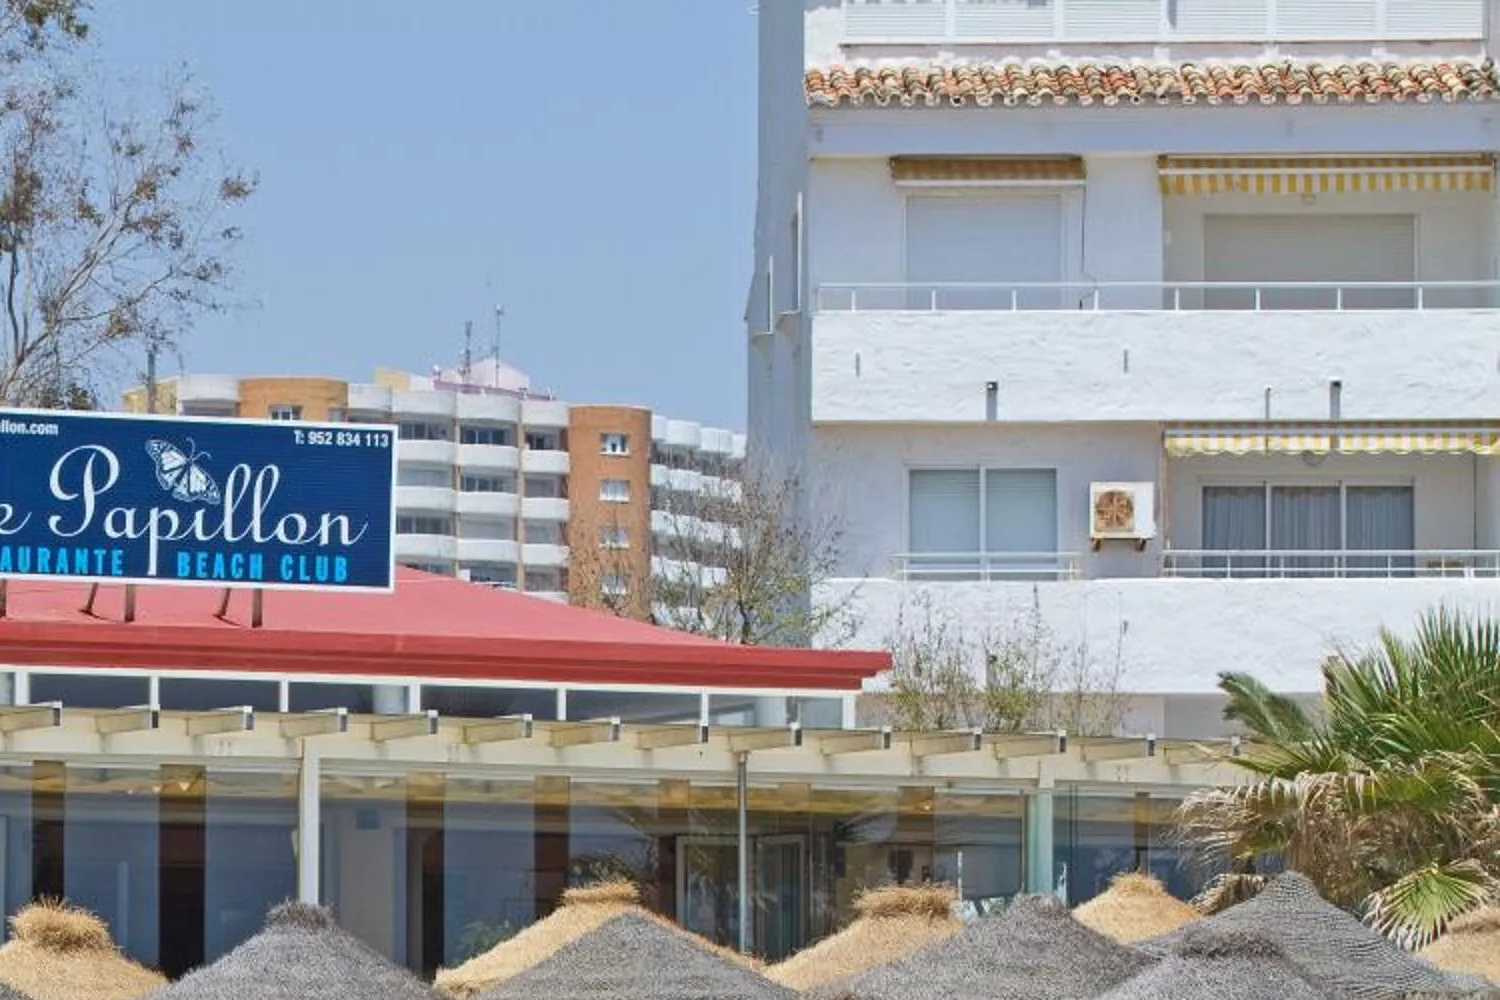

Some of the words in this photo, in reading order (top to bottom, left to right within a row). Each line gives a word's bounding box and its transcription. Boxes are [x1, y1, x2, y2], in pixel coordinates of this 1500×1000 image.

[294, 430, 305, 445] T:
[308, 430, 333, 446] 952
[336, 431, 360, 447] 834
[365, 433, 389, 448] 113
[48, 445, 368, 576] Papillon
[177, 551, 263, 580] BEACH
[280, 554, 347, 583] CLUB
